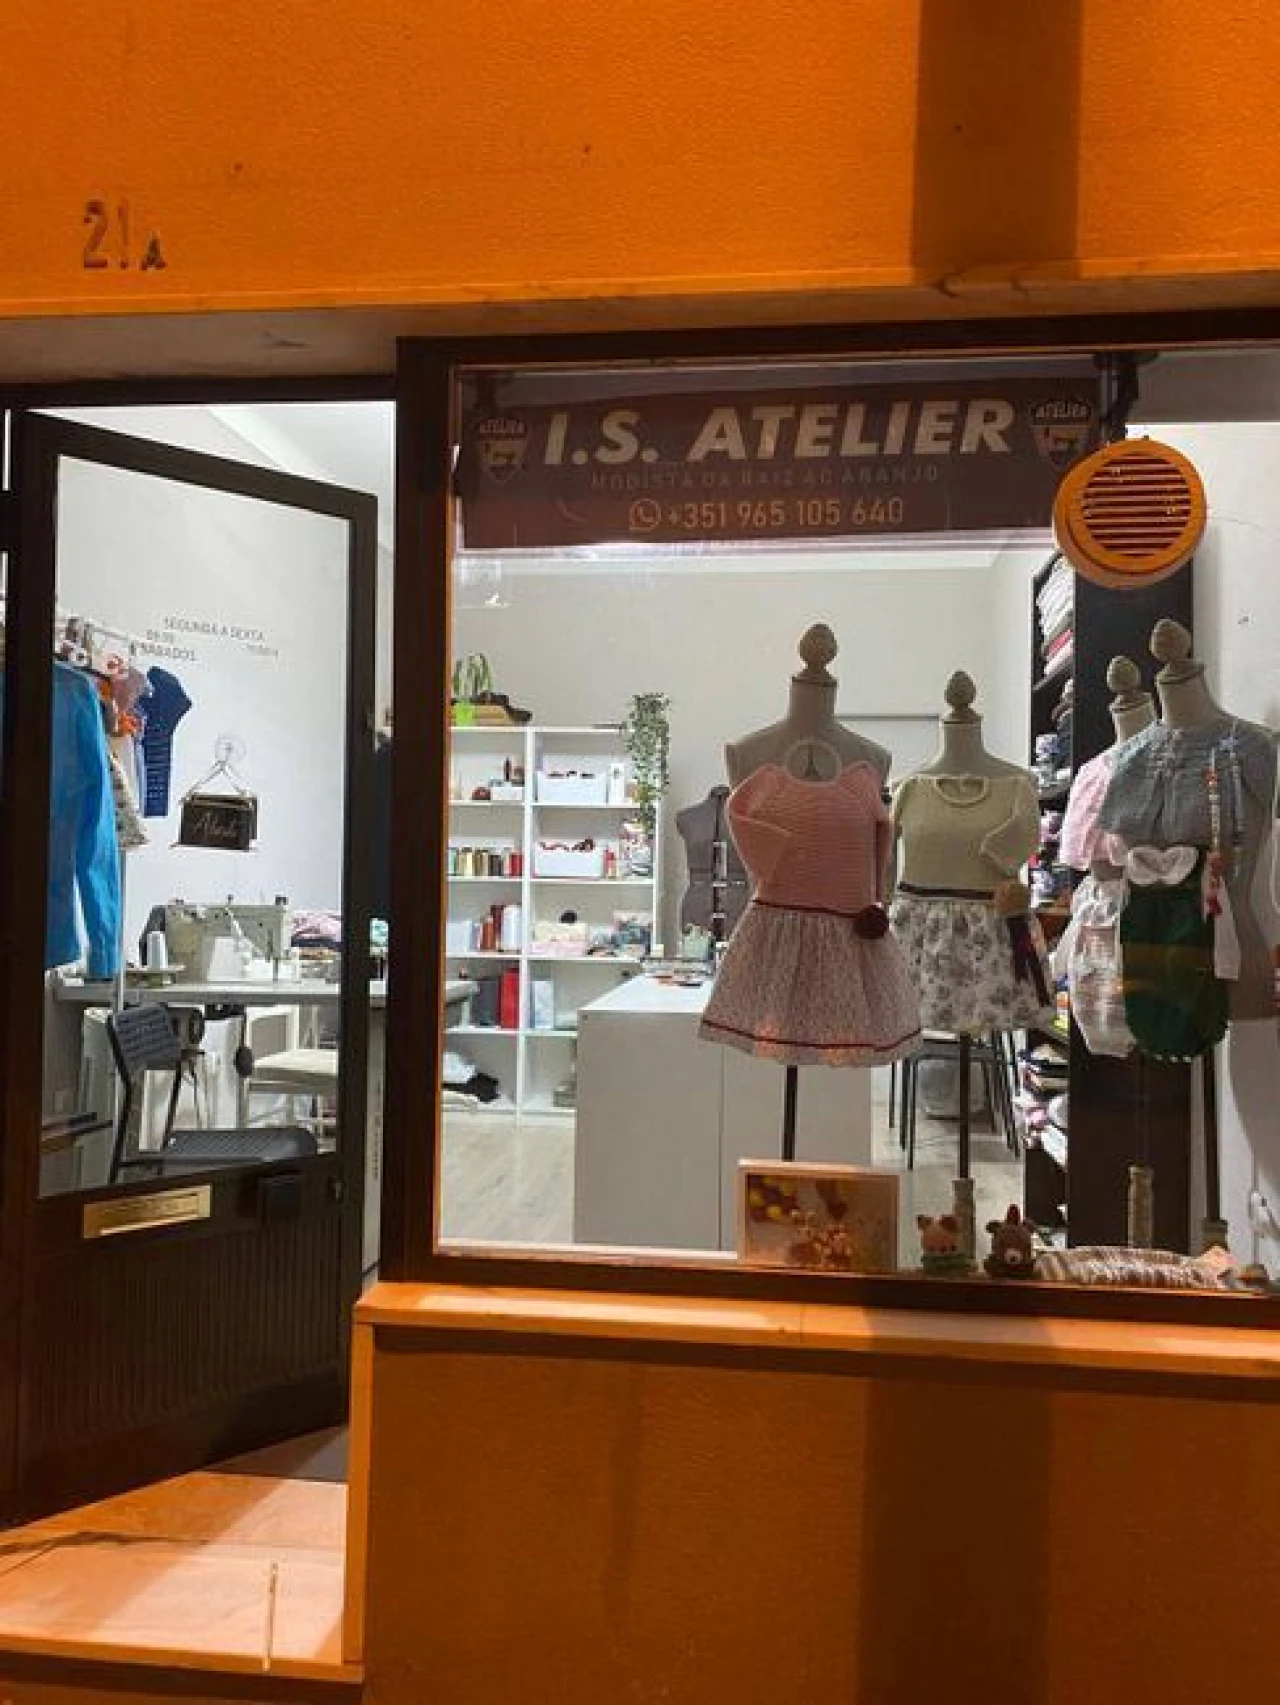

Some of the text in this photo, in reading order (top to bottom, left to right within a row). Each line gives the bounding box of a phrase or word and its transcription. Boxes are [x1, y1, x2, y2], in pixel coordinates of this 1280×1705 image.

[544, 398, 1015, 466] I.S. ATELIER
[667, 496, 904, 529] +351 965 105 640
